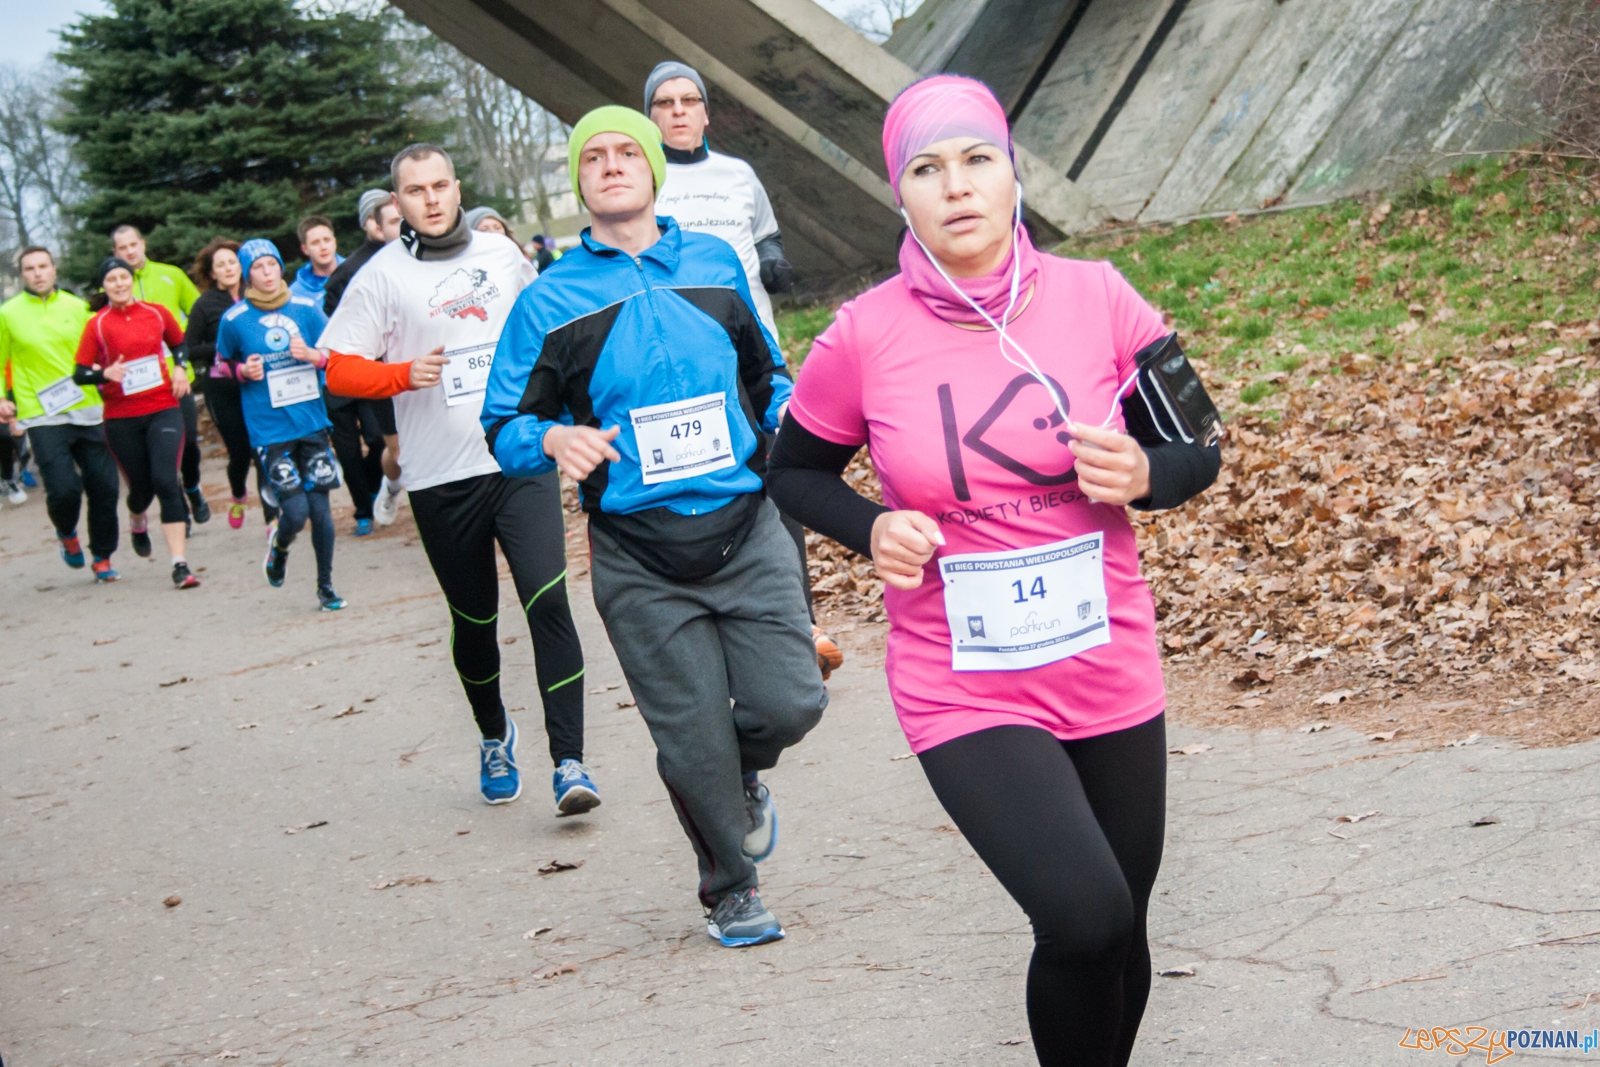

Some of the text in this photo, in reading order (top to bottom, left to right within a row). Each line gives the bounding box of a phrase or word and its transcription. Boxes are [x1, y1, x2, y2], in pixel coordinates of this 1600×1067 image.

[683, 192, 690, 200] do
[468, 354, 492, 370] 862
[285, 376, 301, 385] 405
[653, 409, 683, 420] POWSTANIA
[670, 419, 702, 440] 479
[935, 499, 1022, 525] KOBIETY
[949, 541, 1096, 572] I BIEG POWSTANIA WIELKOPOLSKIEGO
[1011, 576, 1047, 604] 14
[1010, 611, 1061, 638] parkrun
[1037, 639, 1055, 650] grudnia
